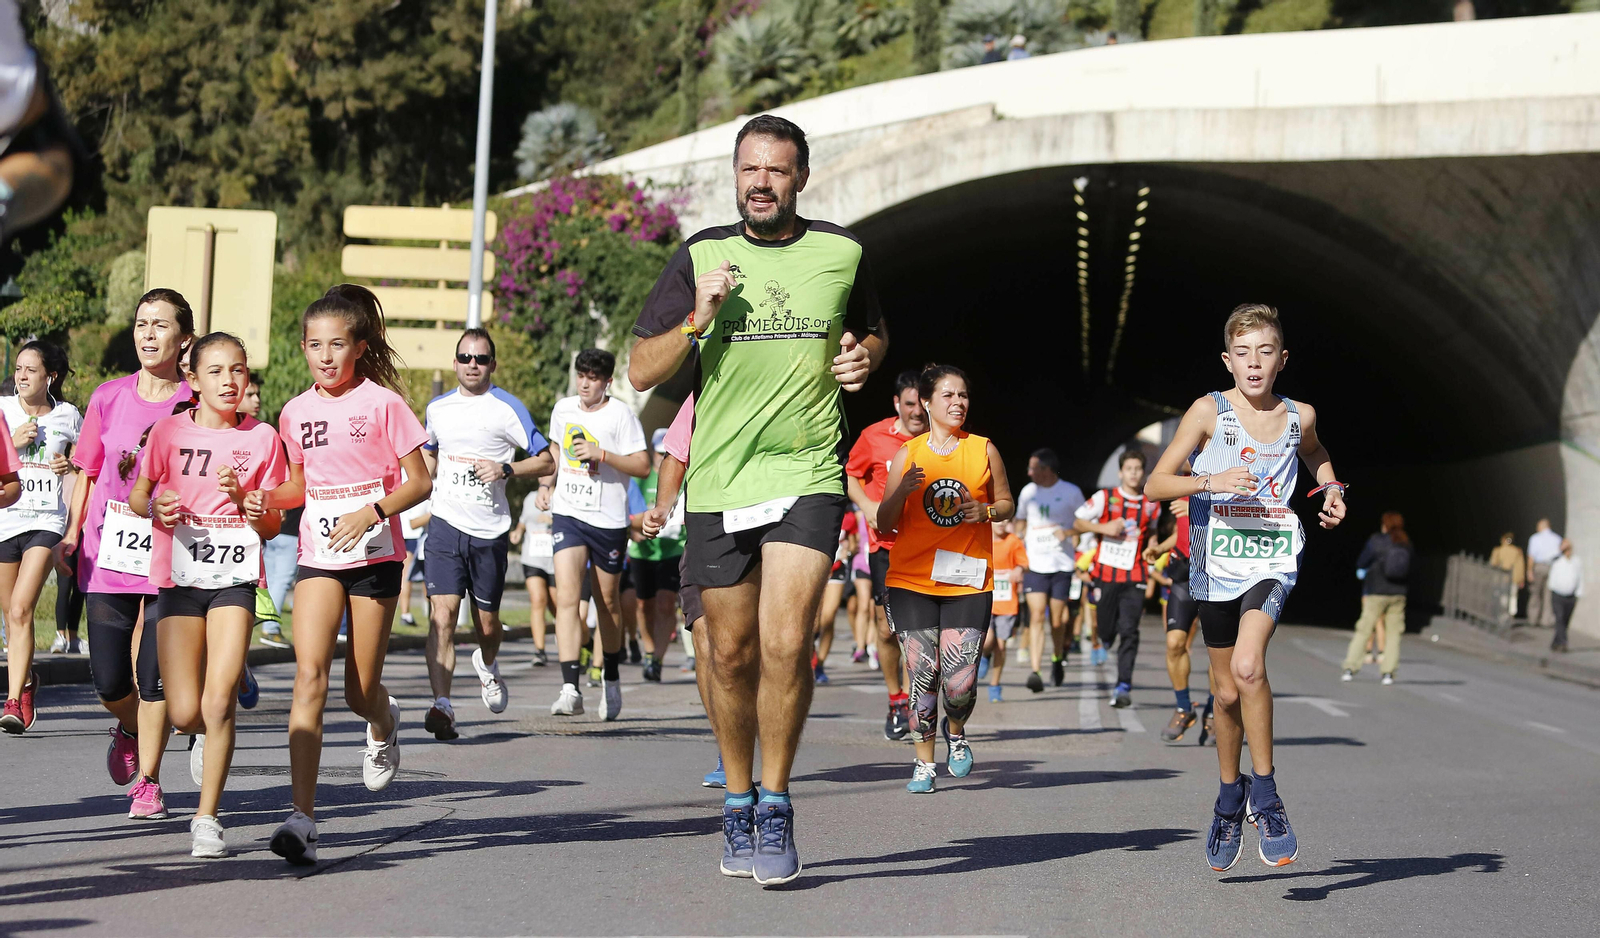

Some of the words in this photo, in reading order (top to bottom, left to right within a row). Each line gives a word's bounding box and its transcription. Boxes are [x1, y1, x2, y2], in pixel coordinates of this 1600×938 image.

[722, 317, 832, 334] PRIMEGUIS.org
[301, 421, 328, 449] 22
[180, 449, 212, 476] 77
[308, 488, 318, 500] 41
[319, 487, 350, 495] CARRERA
[352, 481, 381, 492] URBANA
[565, 482, 592, 496] 1974
[932, 480, 960, 490] BEER
[110, 502, 121, 514] 41
[1214, 505, 1229, 517] 41
[116, 530, 152, 552] 124
[1213, 534, 1289, 558] 20592
[189, 542, 245, 564] 1278
